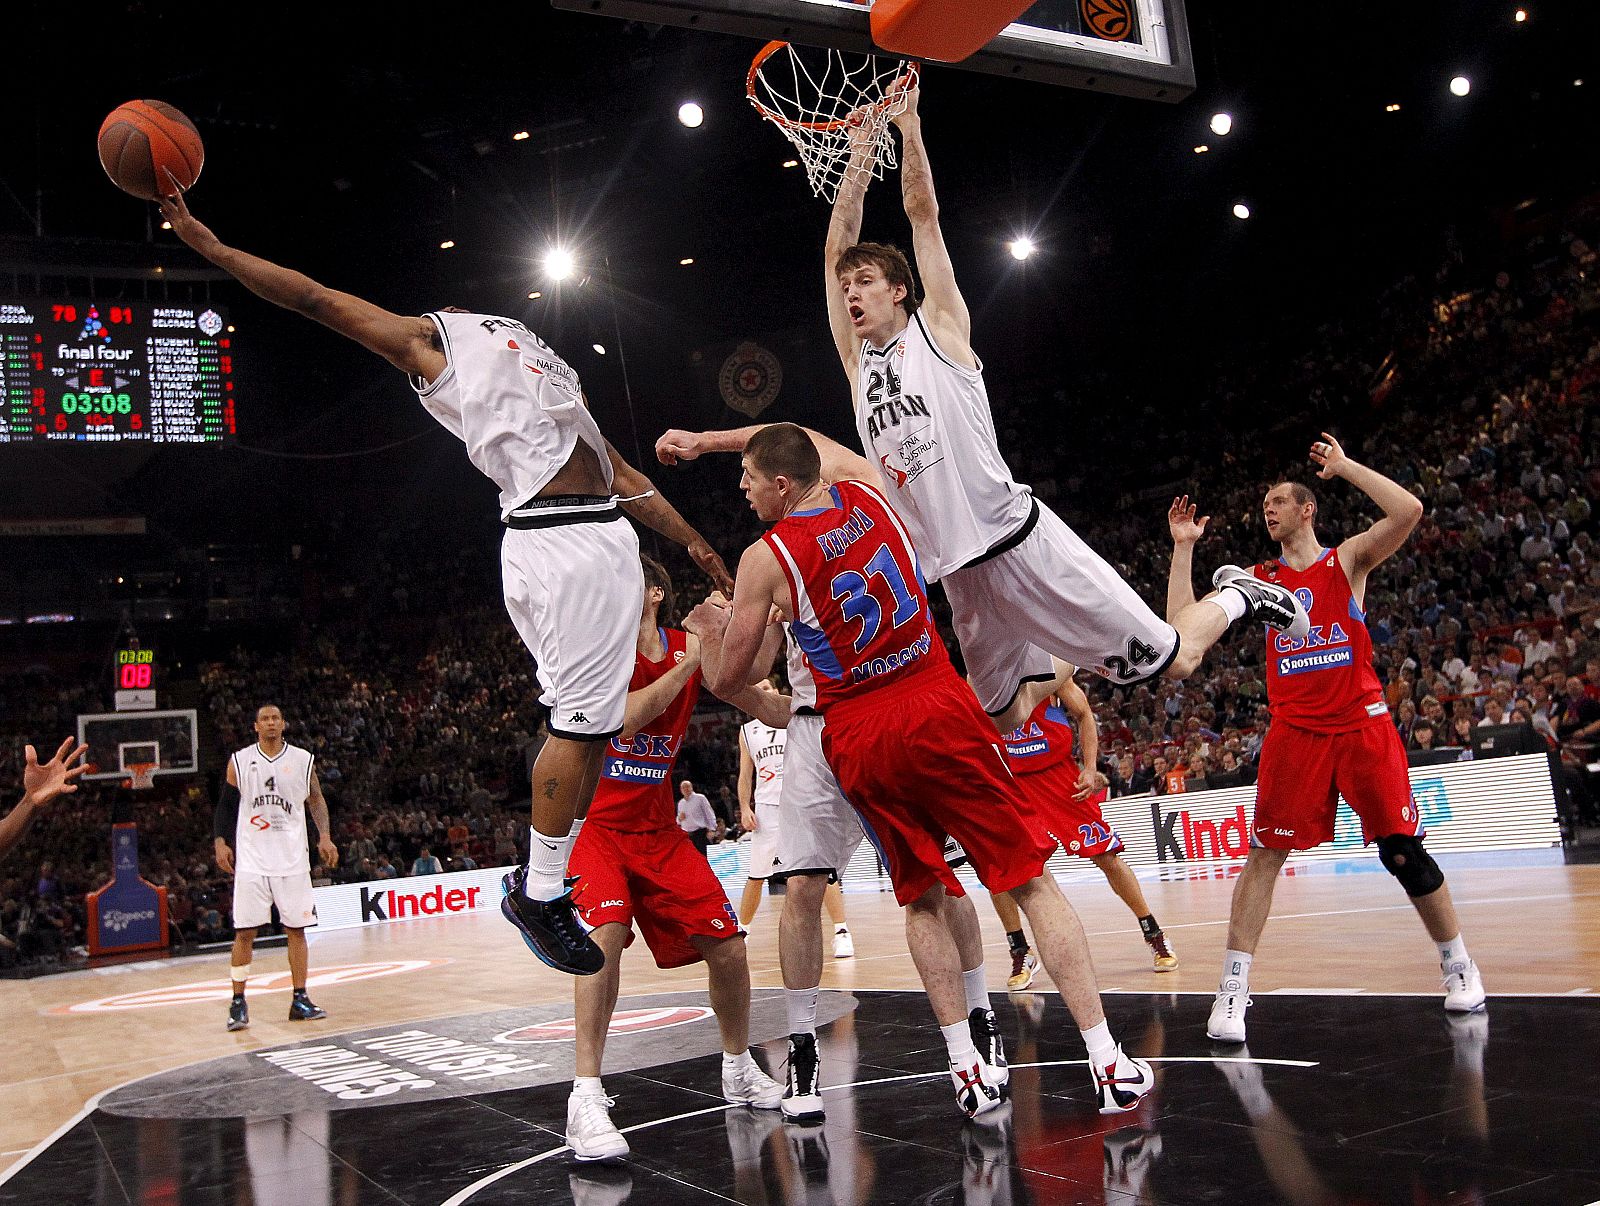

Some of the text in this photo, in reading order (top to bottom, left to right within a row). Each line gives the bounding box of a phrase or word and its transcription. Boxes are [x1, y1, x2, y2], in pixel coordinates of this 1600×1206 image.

[0, 315, 34, 324] OSCOW
[110, 306, 132, 324] 81
[58, 344, 134, 360] final four
[866, 361, 901, 404] 24
[62, 393, 132, 414] 03:08
[532, 499, 557, 508] NIKE
[557, 497, 579, 506] PRO
[831, 543, 920, 654] 31
[851, 628, 932, 684] MOSCOW
[1103, 635, 1161, 680] 24
[1291, 652, 1350, 669] ROSTELECOM
[121, 664, 152, 688] 08
[766, 729, 777, 743] 7
[756, 745, 785, 762] ARTIZ
[264, 776, 275, 792] 4
[252, 794, 293, 815] ARTIZAN
[1078, 821, 1112, 848] 21
[1151, 803, 1249, 860] kind
[600, 899, 624, 907] UAC
[352, 1030, 552, 1081] TURKISH
[256, 1045, 436, 1100] AIRLINES
